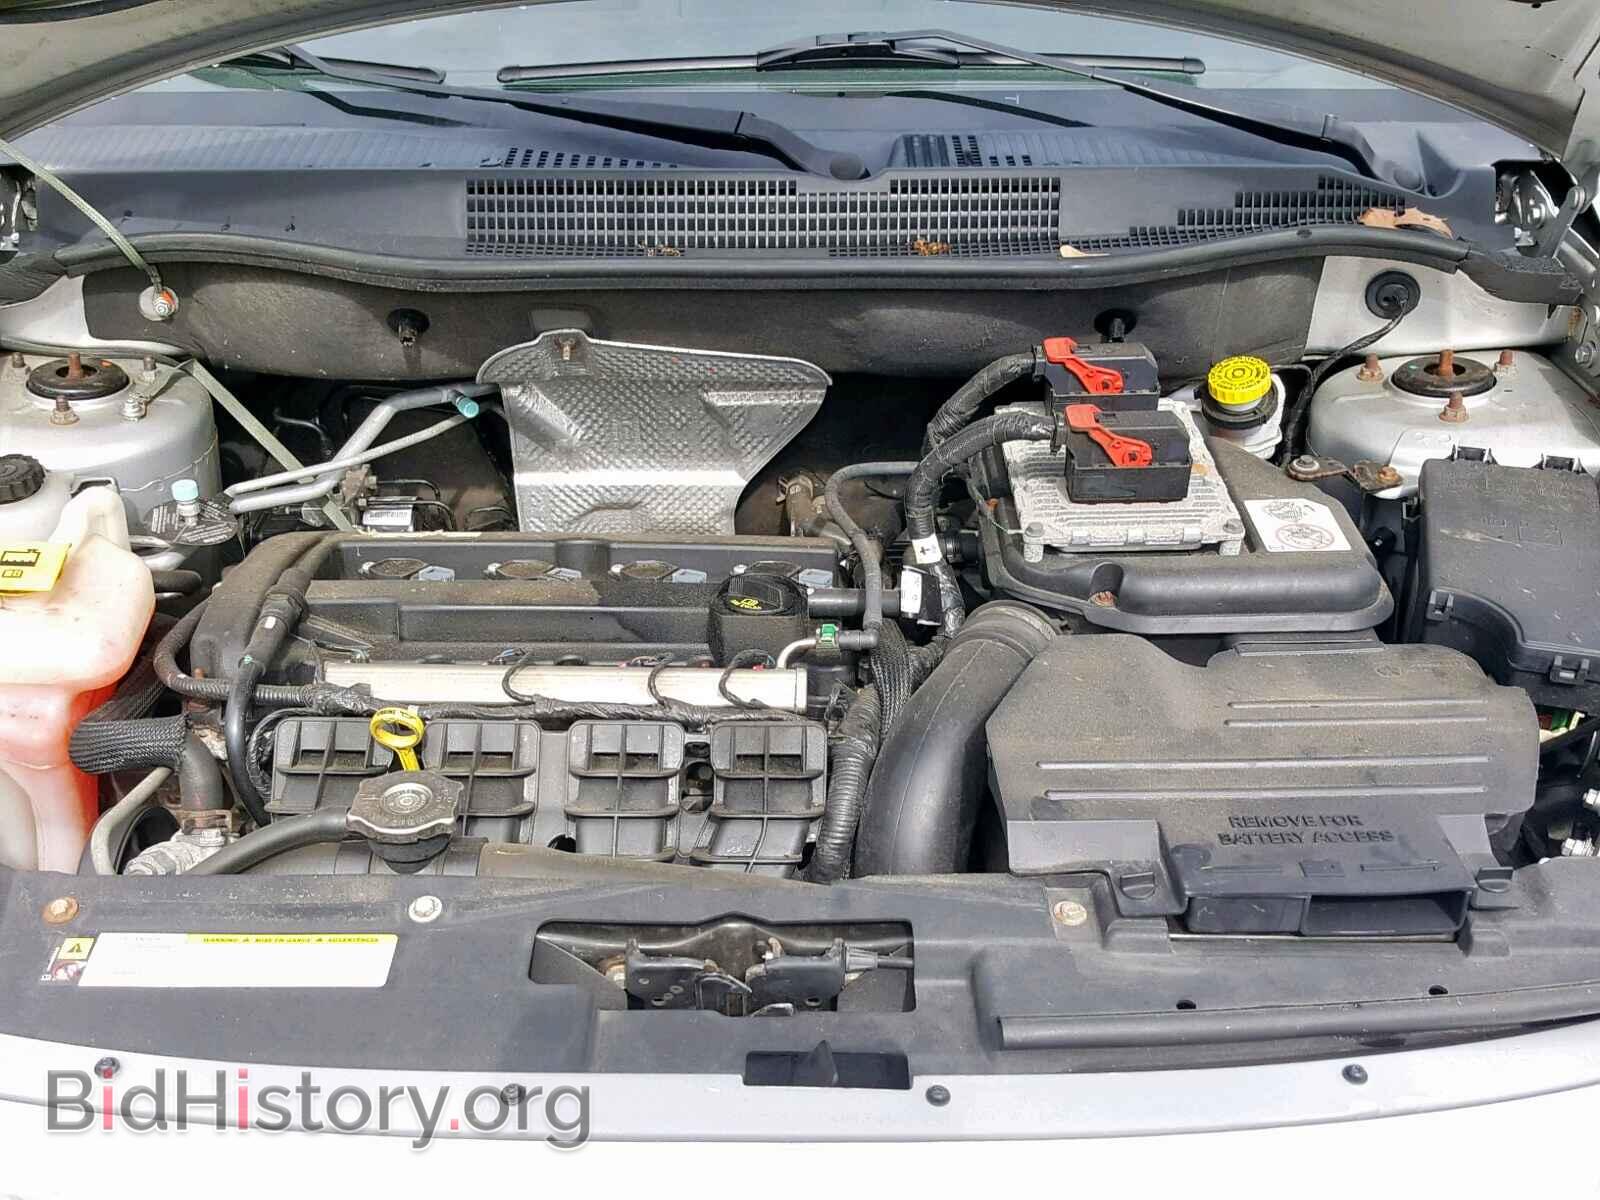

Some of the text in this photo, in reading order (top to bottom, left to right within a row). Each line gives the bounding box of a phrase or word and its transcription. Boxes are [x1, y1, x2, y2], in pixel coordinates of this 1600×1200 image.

[1228, 815, 1363, 828] REMOVE FOR
[1218, 830, 1394, 845] BATTERY ACCESS
